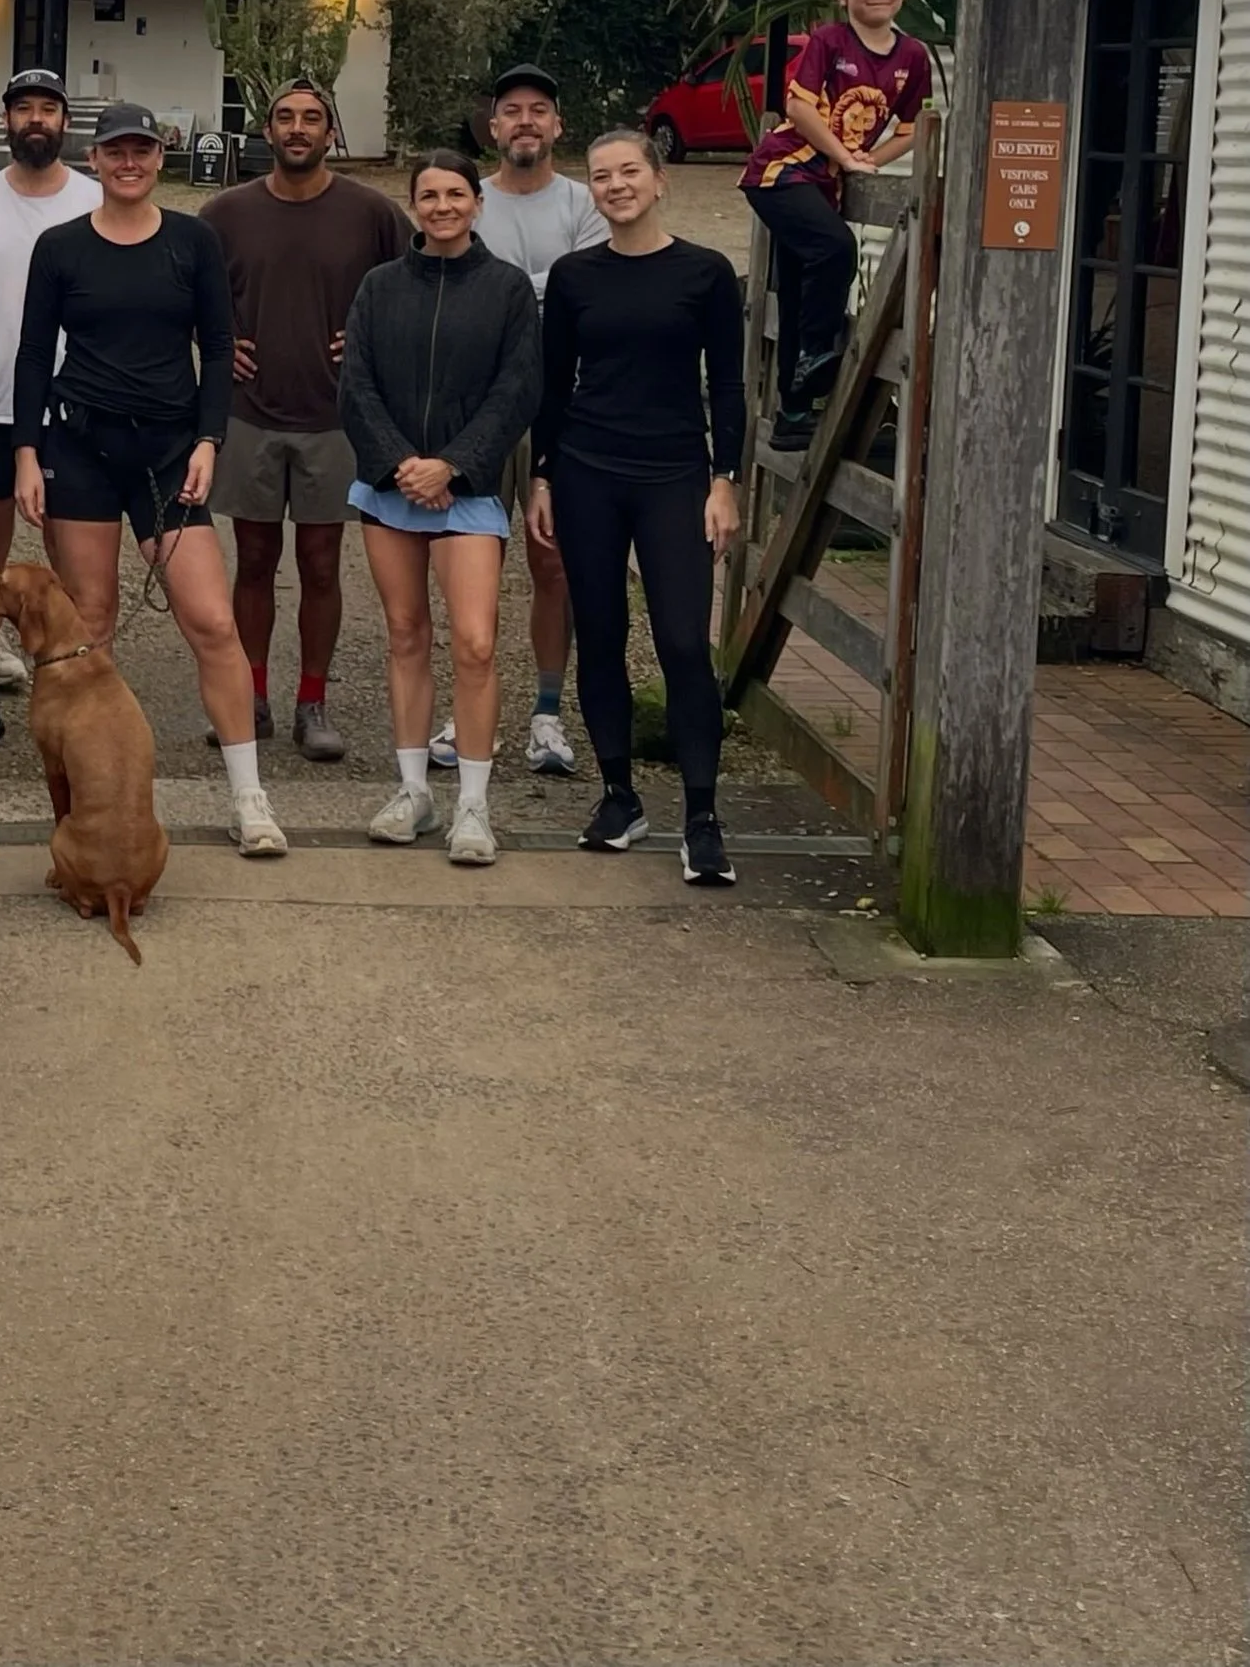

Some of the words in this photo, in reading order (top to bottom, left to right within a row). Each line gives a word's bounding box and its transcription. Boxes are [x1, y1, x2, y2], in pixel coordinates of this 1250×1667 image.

[998, 142, 1015, 154] NO
[1016, 143, 1056, 156] ENTRY
[1000, 169, 1048, 181] VISITORS
[1009, 184, 1038, 196] CARS
[1009, 198, 1037, 210] ONLY
